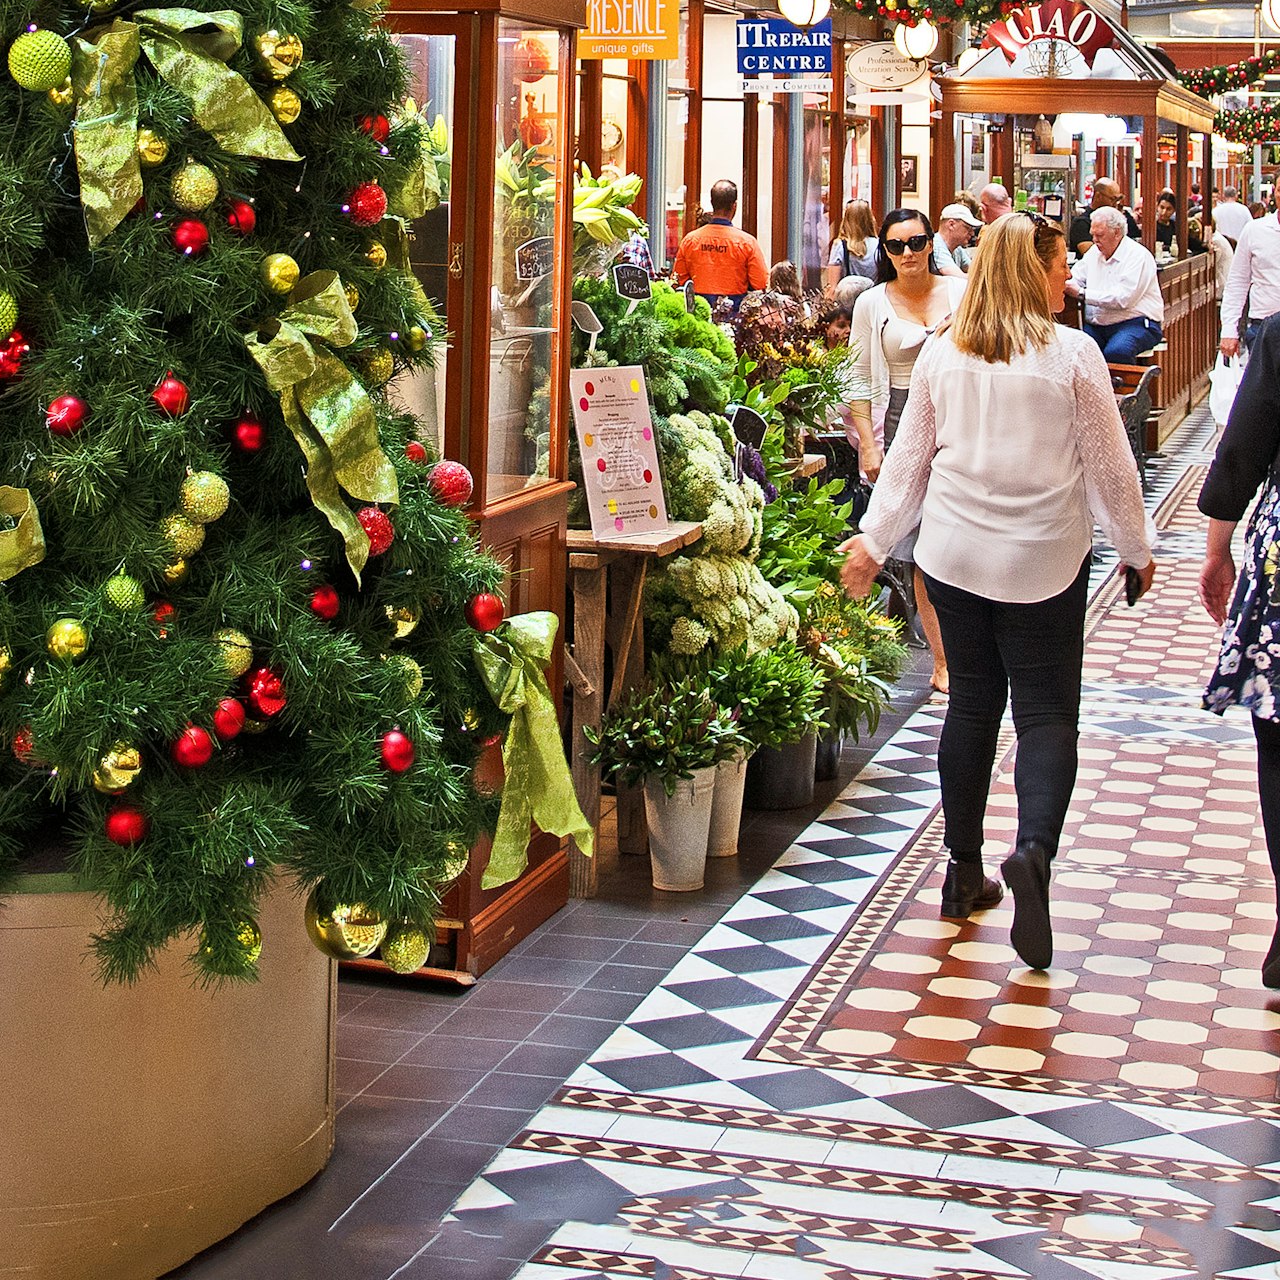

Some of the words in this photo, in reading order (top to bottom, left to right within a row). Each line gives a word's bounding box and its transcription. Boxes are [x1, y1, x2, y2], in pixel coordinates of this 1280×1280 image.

[1005, 4, 1097, 46] CIAO
[737, 23, 769, 48] IT
[766, 32, 831, 47] REPAIR
[591, 43, 628, 55] unique
[631, 42, 655, 56] gifts
[743, 55, 826, 70] CENTRE
[867, 57, 909, 65] Professional
[894, 65, 920, 73] Service
[701, 244, 728, 253] IMPACT
[599, 375, 617, 384] MENU
